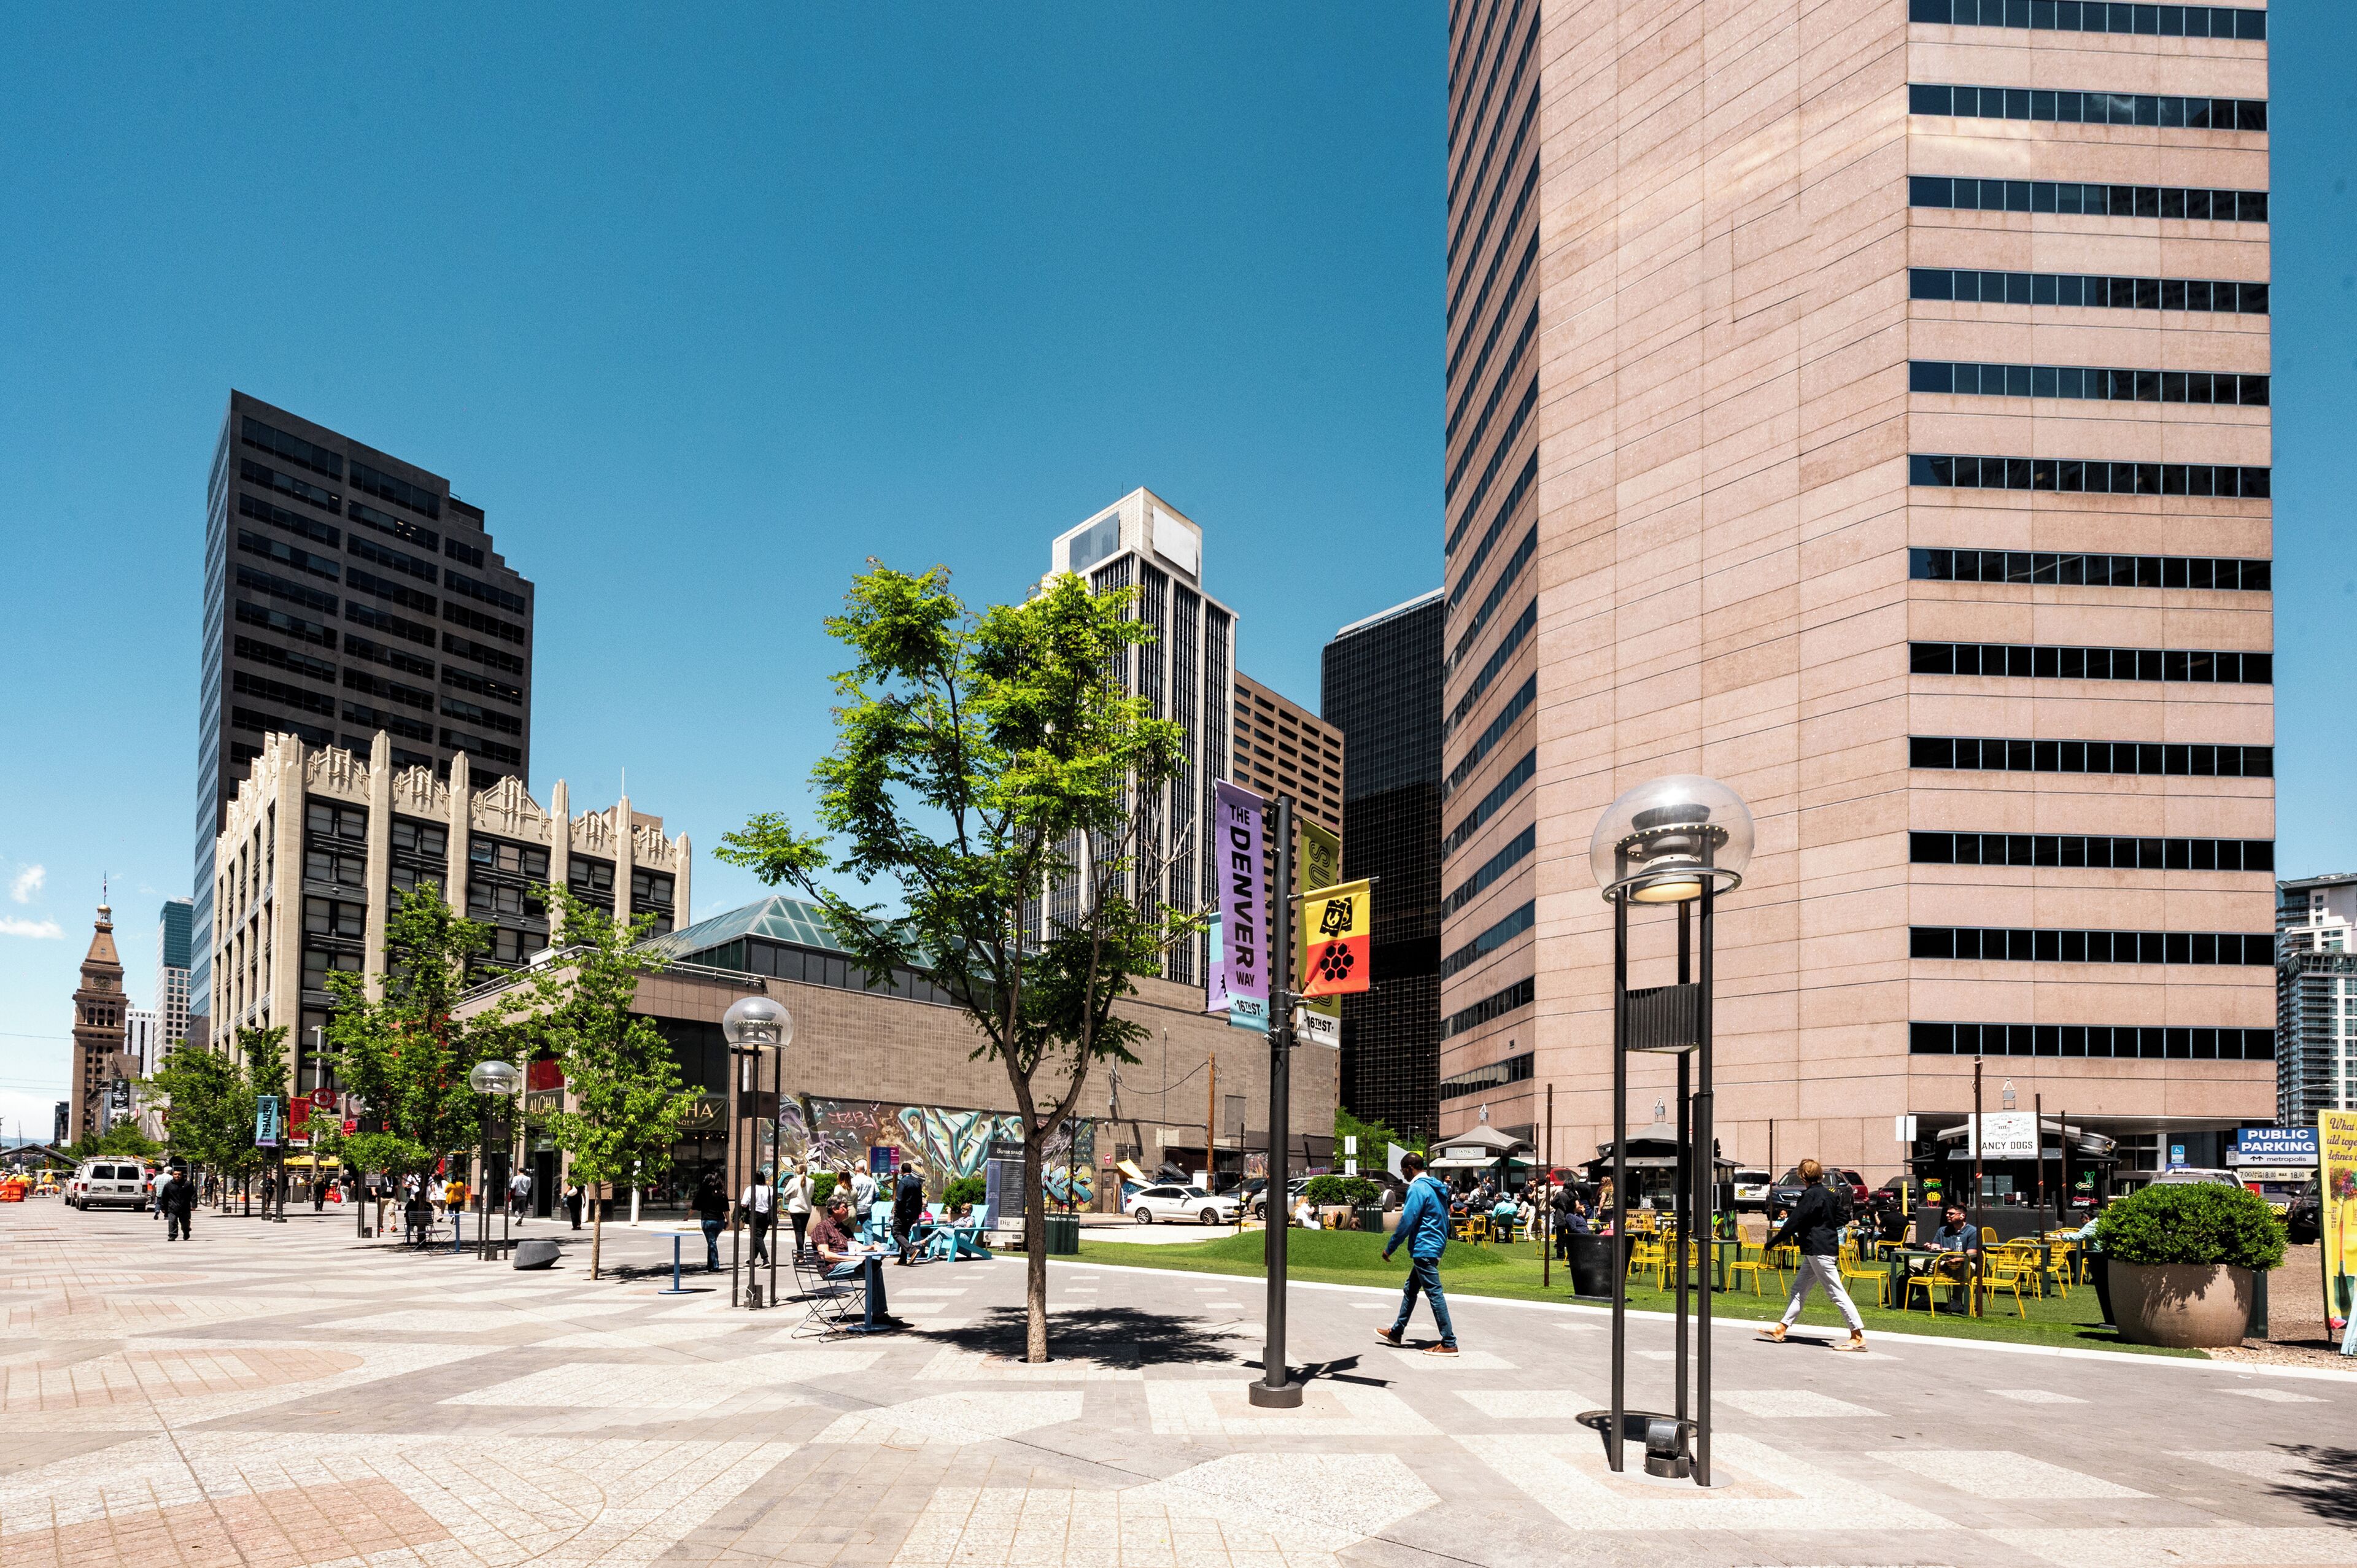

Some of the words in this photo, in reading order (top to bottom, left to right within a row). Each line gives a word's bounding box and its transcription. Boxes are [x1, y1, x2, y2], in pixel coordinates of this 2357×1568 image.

[1229, 804, 1250, 825] THE
[1230, 825, 1255, 969] DENVER
[1236, 970, 1255, 987] WAY
[529, 1095, 557, 1115] ALOHA
[262, 1104, 272, 1134] DENVER
[2329, 1118, 2355, 1130] What
[2248, 1129, 2309, 1140] PUBLIC
[2327, 1134, 2340, 1146] uild
[2010, 1141, 2033, 1149] DOGS
[2241, 1141, 2315, 1152] PARKING
